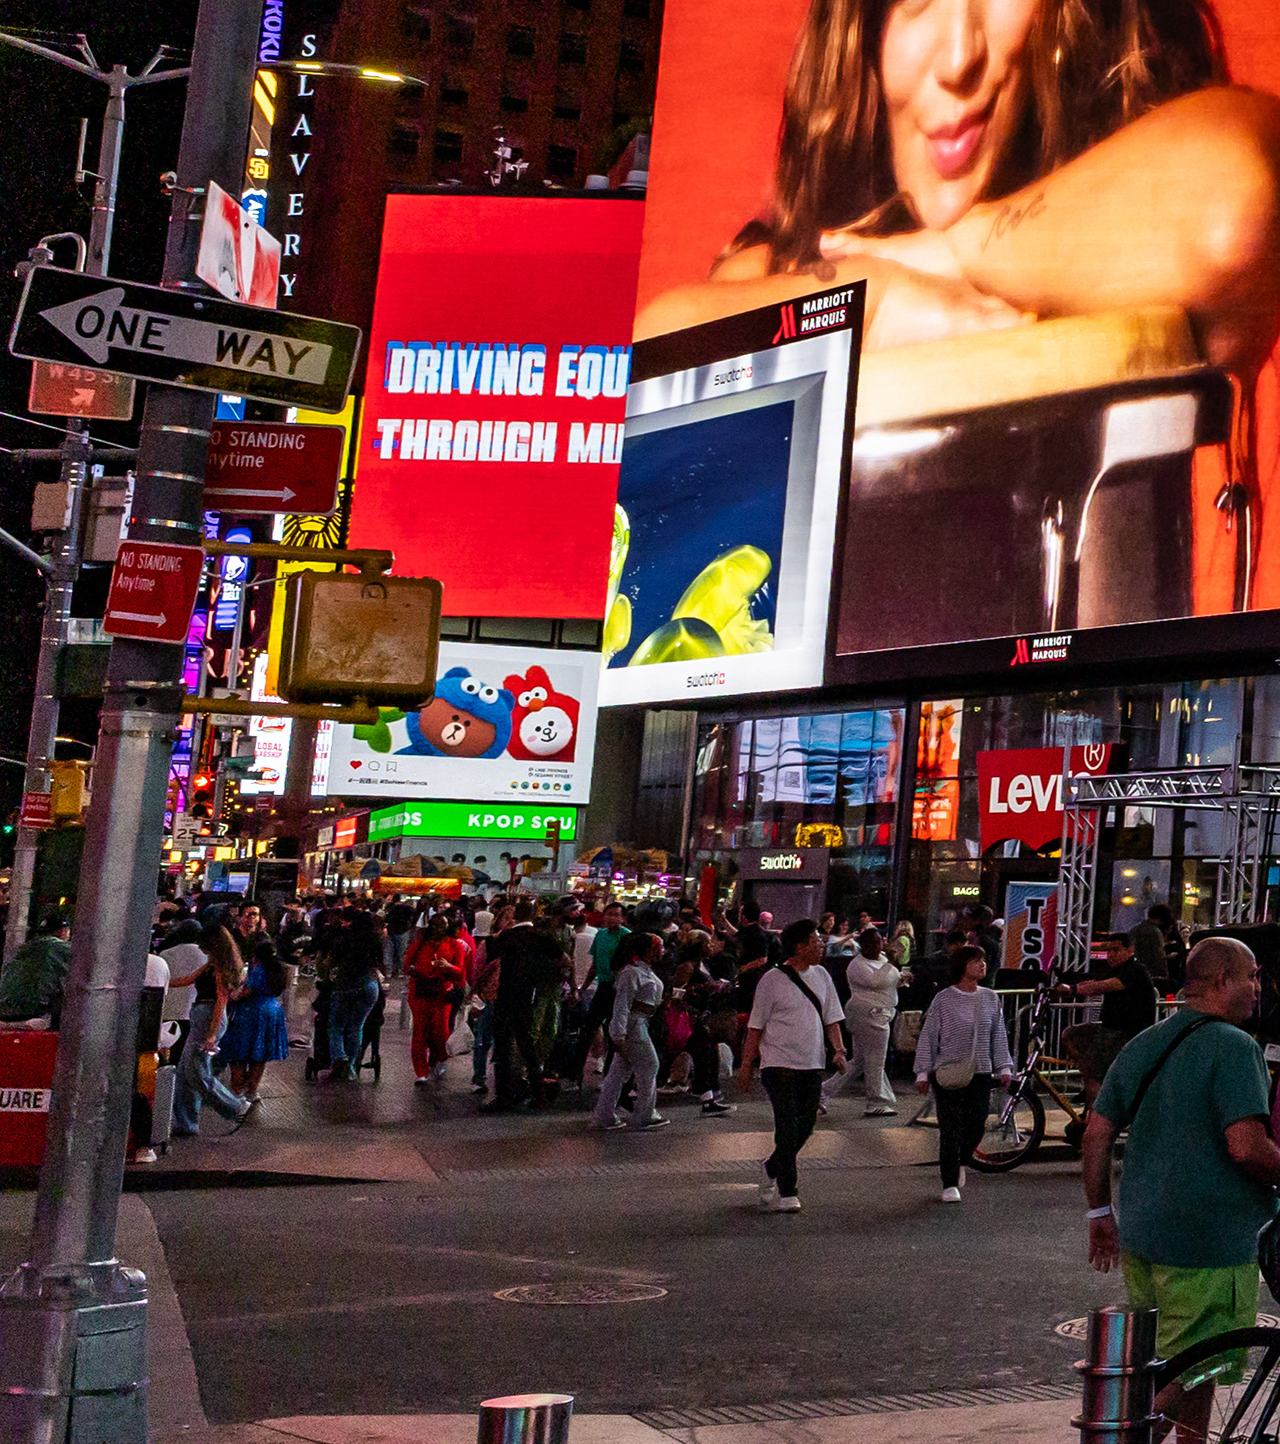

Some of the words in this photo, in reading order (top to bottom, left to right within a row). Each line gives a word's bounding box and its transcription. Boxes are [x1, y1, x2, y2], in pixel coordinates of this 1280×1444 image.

[281, 34, 316, 296] SLAVERY
[802, 290, 854, 315] MARRIOTT
[801, 309, 846, 332] MARQUIS
[75, 305, 172, 352] ONE
[216, 330, 313, 375] WAY
[386, 344, 547, 396] DRIVING
[713, 368, 748, 387] swatch
[229, 430, 306, 450] STANDING
[376, 418, 556, 463] THROUGH
[208, 451, 265, 470] nytime
[120, 551, 134, 568] NO
[137, 553, 182, 572] STANDING
[117, 572, 156, 592] Anytime
[1033, 635, 1072, 648] MARRIOTT
[1032, 648, 1067, 660] MARQUIS
[686, 673, 719, 688] swatch
[468, 814, 524, 828] KPOP
[177, 829, 197, 839] 25
[761, 855, 798, 871] swatch
